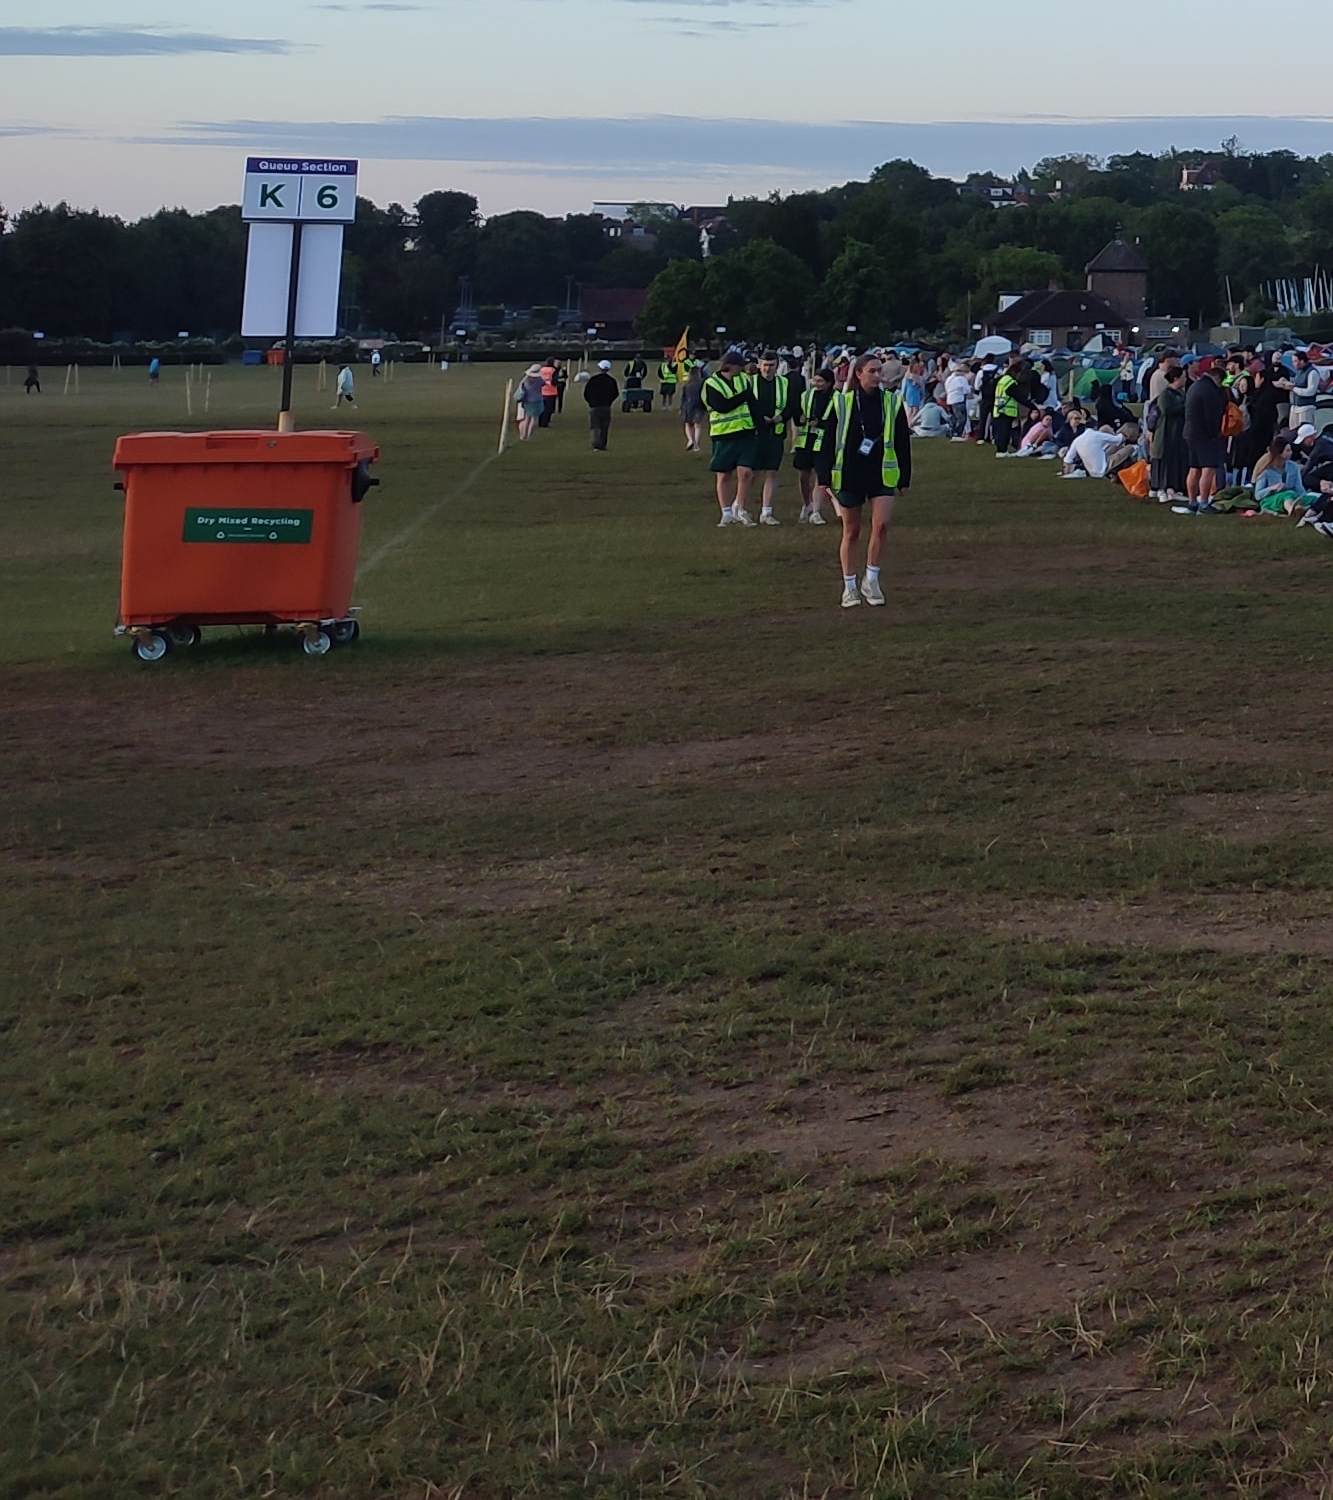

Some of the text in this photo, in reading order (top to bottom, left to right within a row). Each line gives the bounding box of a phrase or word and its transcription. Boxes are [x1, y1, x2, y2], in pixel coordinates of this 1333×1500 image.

[258, 161, 347, 172] Queue Section
[259, 183, 339, 209] K 6
[197, 516, 301, 526] Dry Mixed Recycling
